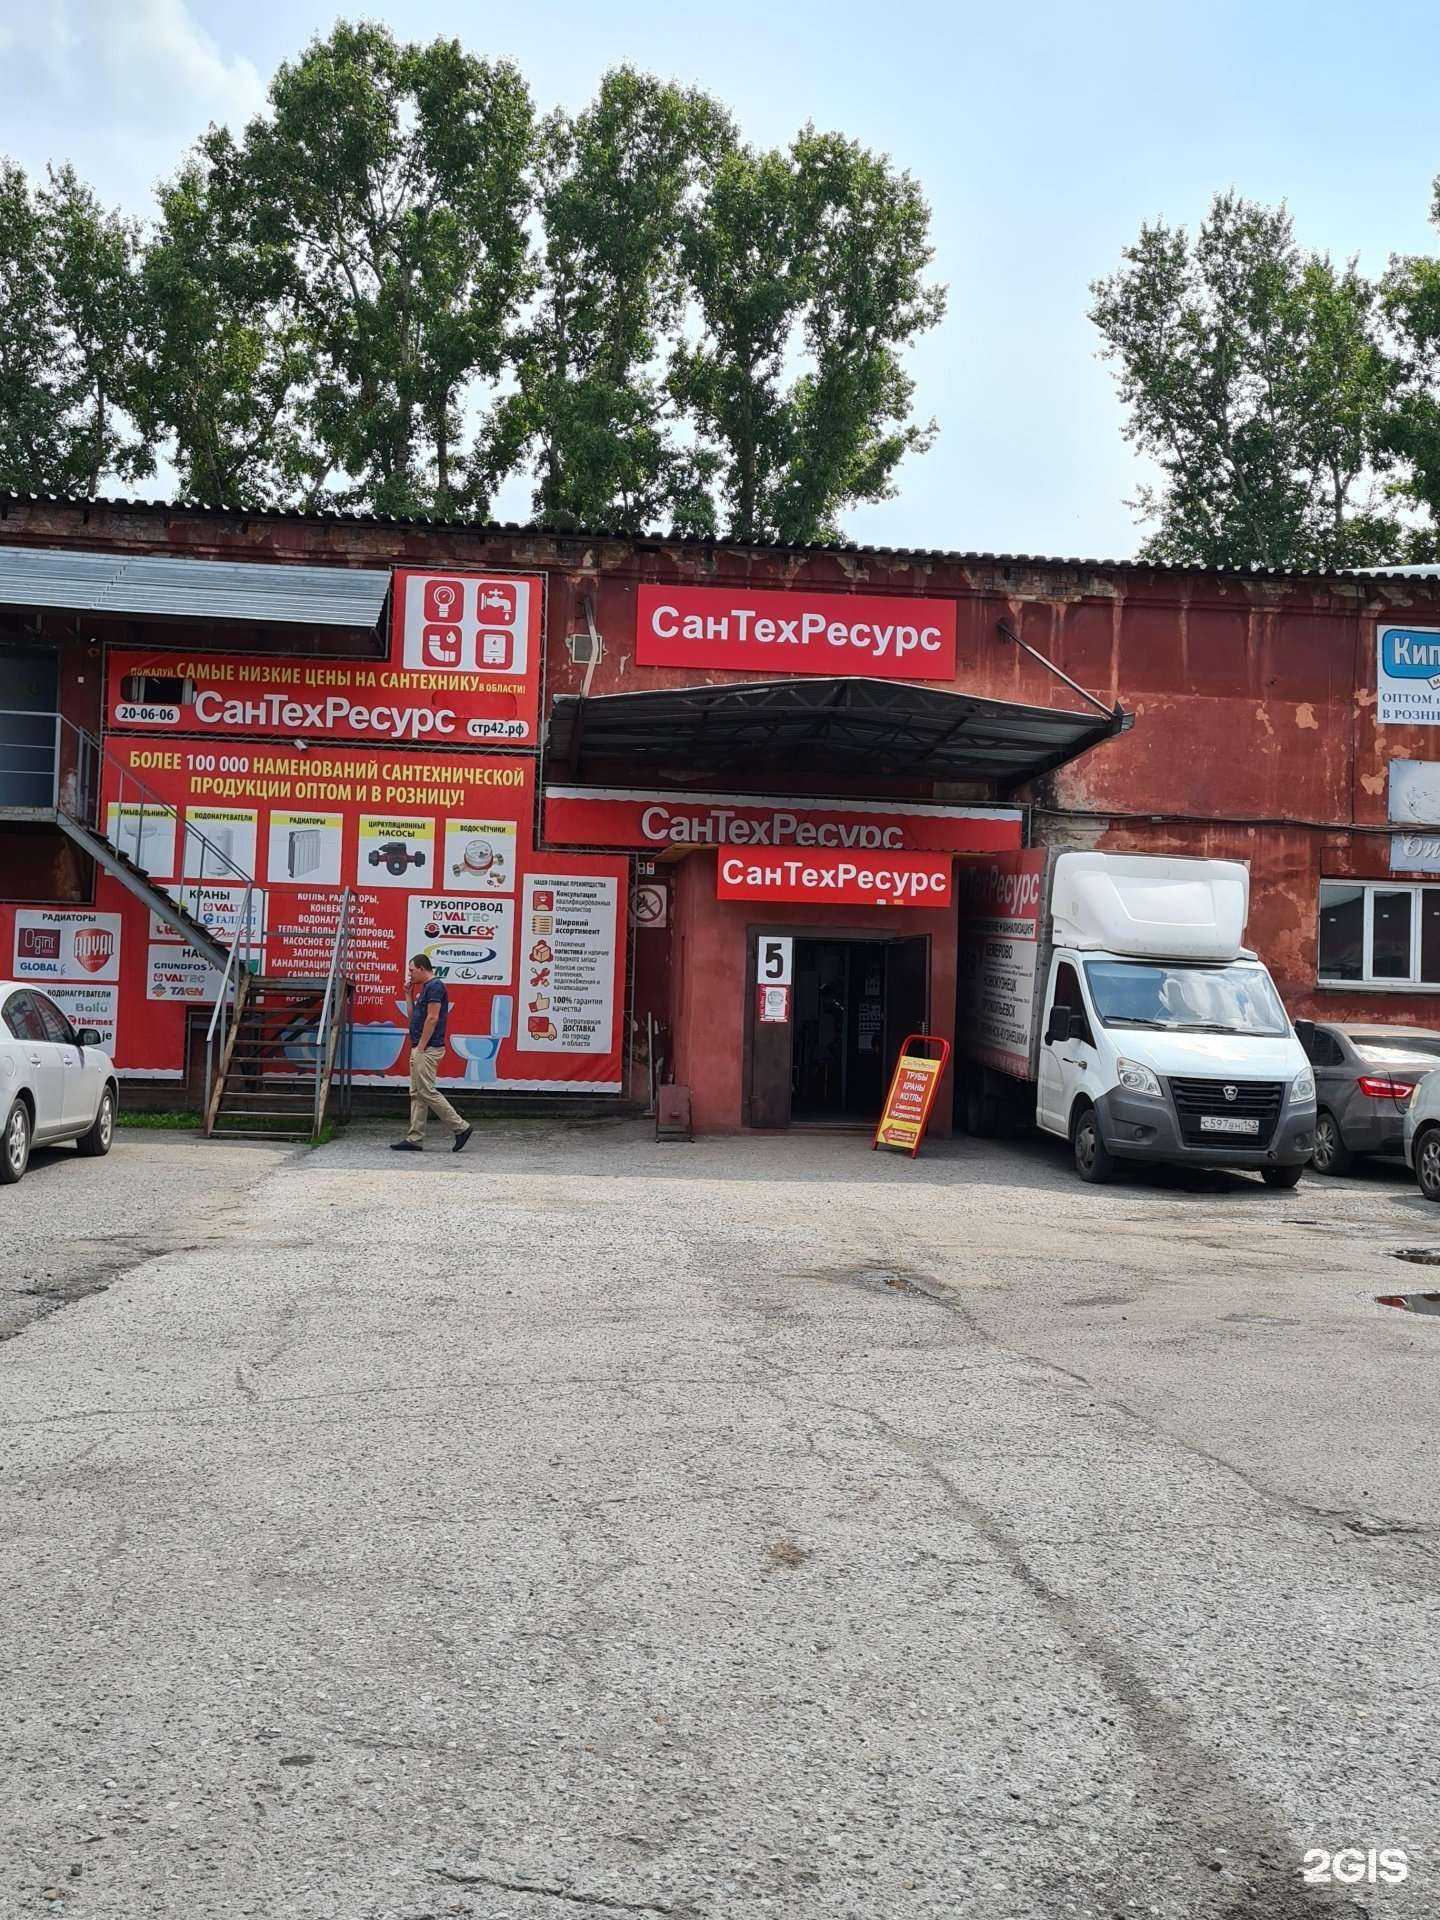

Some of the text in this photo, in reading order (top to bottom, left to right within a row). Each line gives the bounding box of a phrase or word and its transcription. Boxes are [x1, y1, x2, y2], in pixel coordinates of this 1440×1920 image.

[651, 605, 942, 656] СанТехРесурс
[177, 662, 235, 681] САМЫЕ
[239, 665, 301, 684] НИЗКИЕ
[305, 668, 351, 687] ЦЕНЫ
[355, 671, 376, 687] НА
[380, 672, 480, 692] САНТЕХНИКУ
[1382, 693, 1432, 704] ОПТОМ
[121, 707, 174, 721] 20-06-06
[195, 691, 457, 739] СанТехРесурс
[1382, 709, 1391, 719] В
[471, 722, 525, 737] стр42.рф
[130, 751, 525, 787] БОЛЕЕ 100 000 НАМЕНОВАНИЙ САНТЕХНИЧЕСКОЙ
[190, 777, 465, 808] ПРОДУКЦИИ ОПТОМ И В РОЗНИЦУ!
[194, 812, 253, 823] ВОДОНАГРЕВАТЕЛИ
[289, 817, 327, 827] РАДИАТОРЫ
[368, 820, 426, 831] ЦИРКУЛЯЦИОННЫЕ
[641, 806, 904, 849] СанТехРесурс
[378, 829, 416, 839] НАСОСЫ
[722, 858, 947, 900] СанТехРесурс
[189, 890, 230, 900] КРАНЫ
[556, 890, 598, 900] Консультация
[420, 899, 504, 914] ТРУБОПРОВОД
[42, 912, 97, 922] РАДИАТОРЫ
[444, 911, 490, 923] VALTEC
[555, 918, 589, 928] Широкий
[555, 927, 601, 937] ассортимент
[283, 936, 324, 946] НАСОСНОЕ
[765, 942, 784, 978] 5
[20, 962, 58, 972] GLOBAL
[153, 962, 208, 971] GRUNDFOS
[164, 973, 206, 984] VALTEC
[552, 996, 573, 1005] 100%
[562, 1025, 596, 1033] ДОСТАВКА
